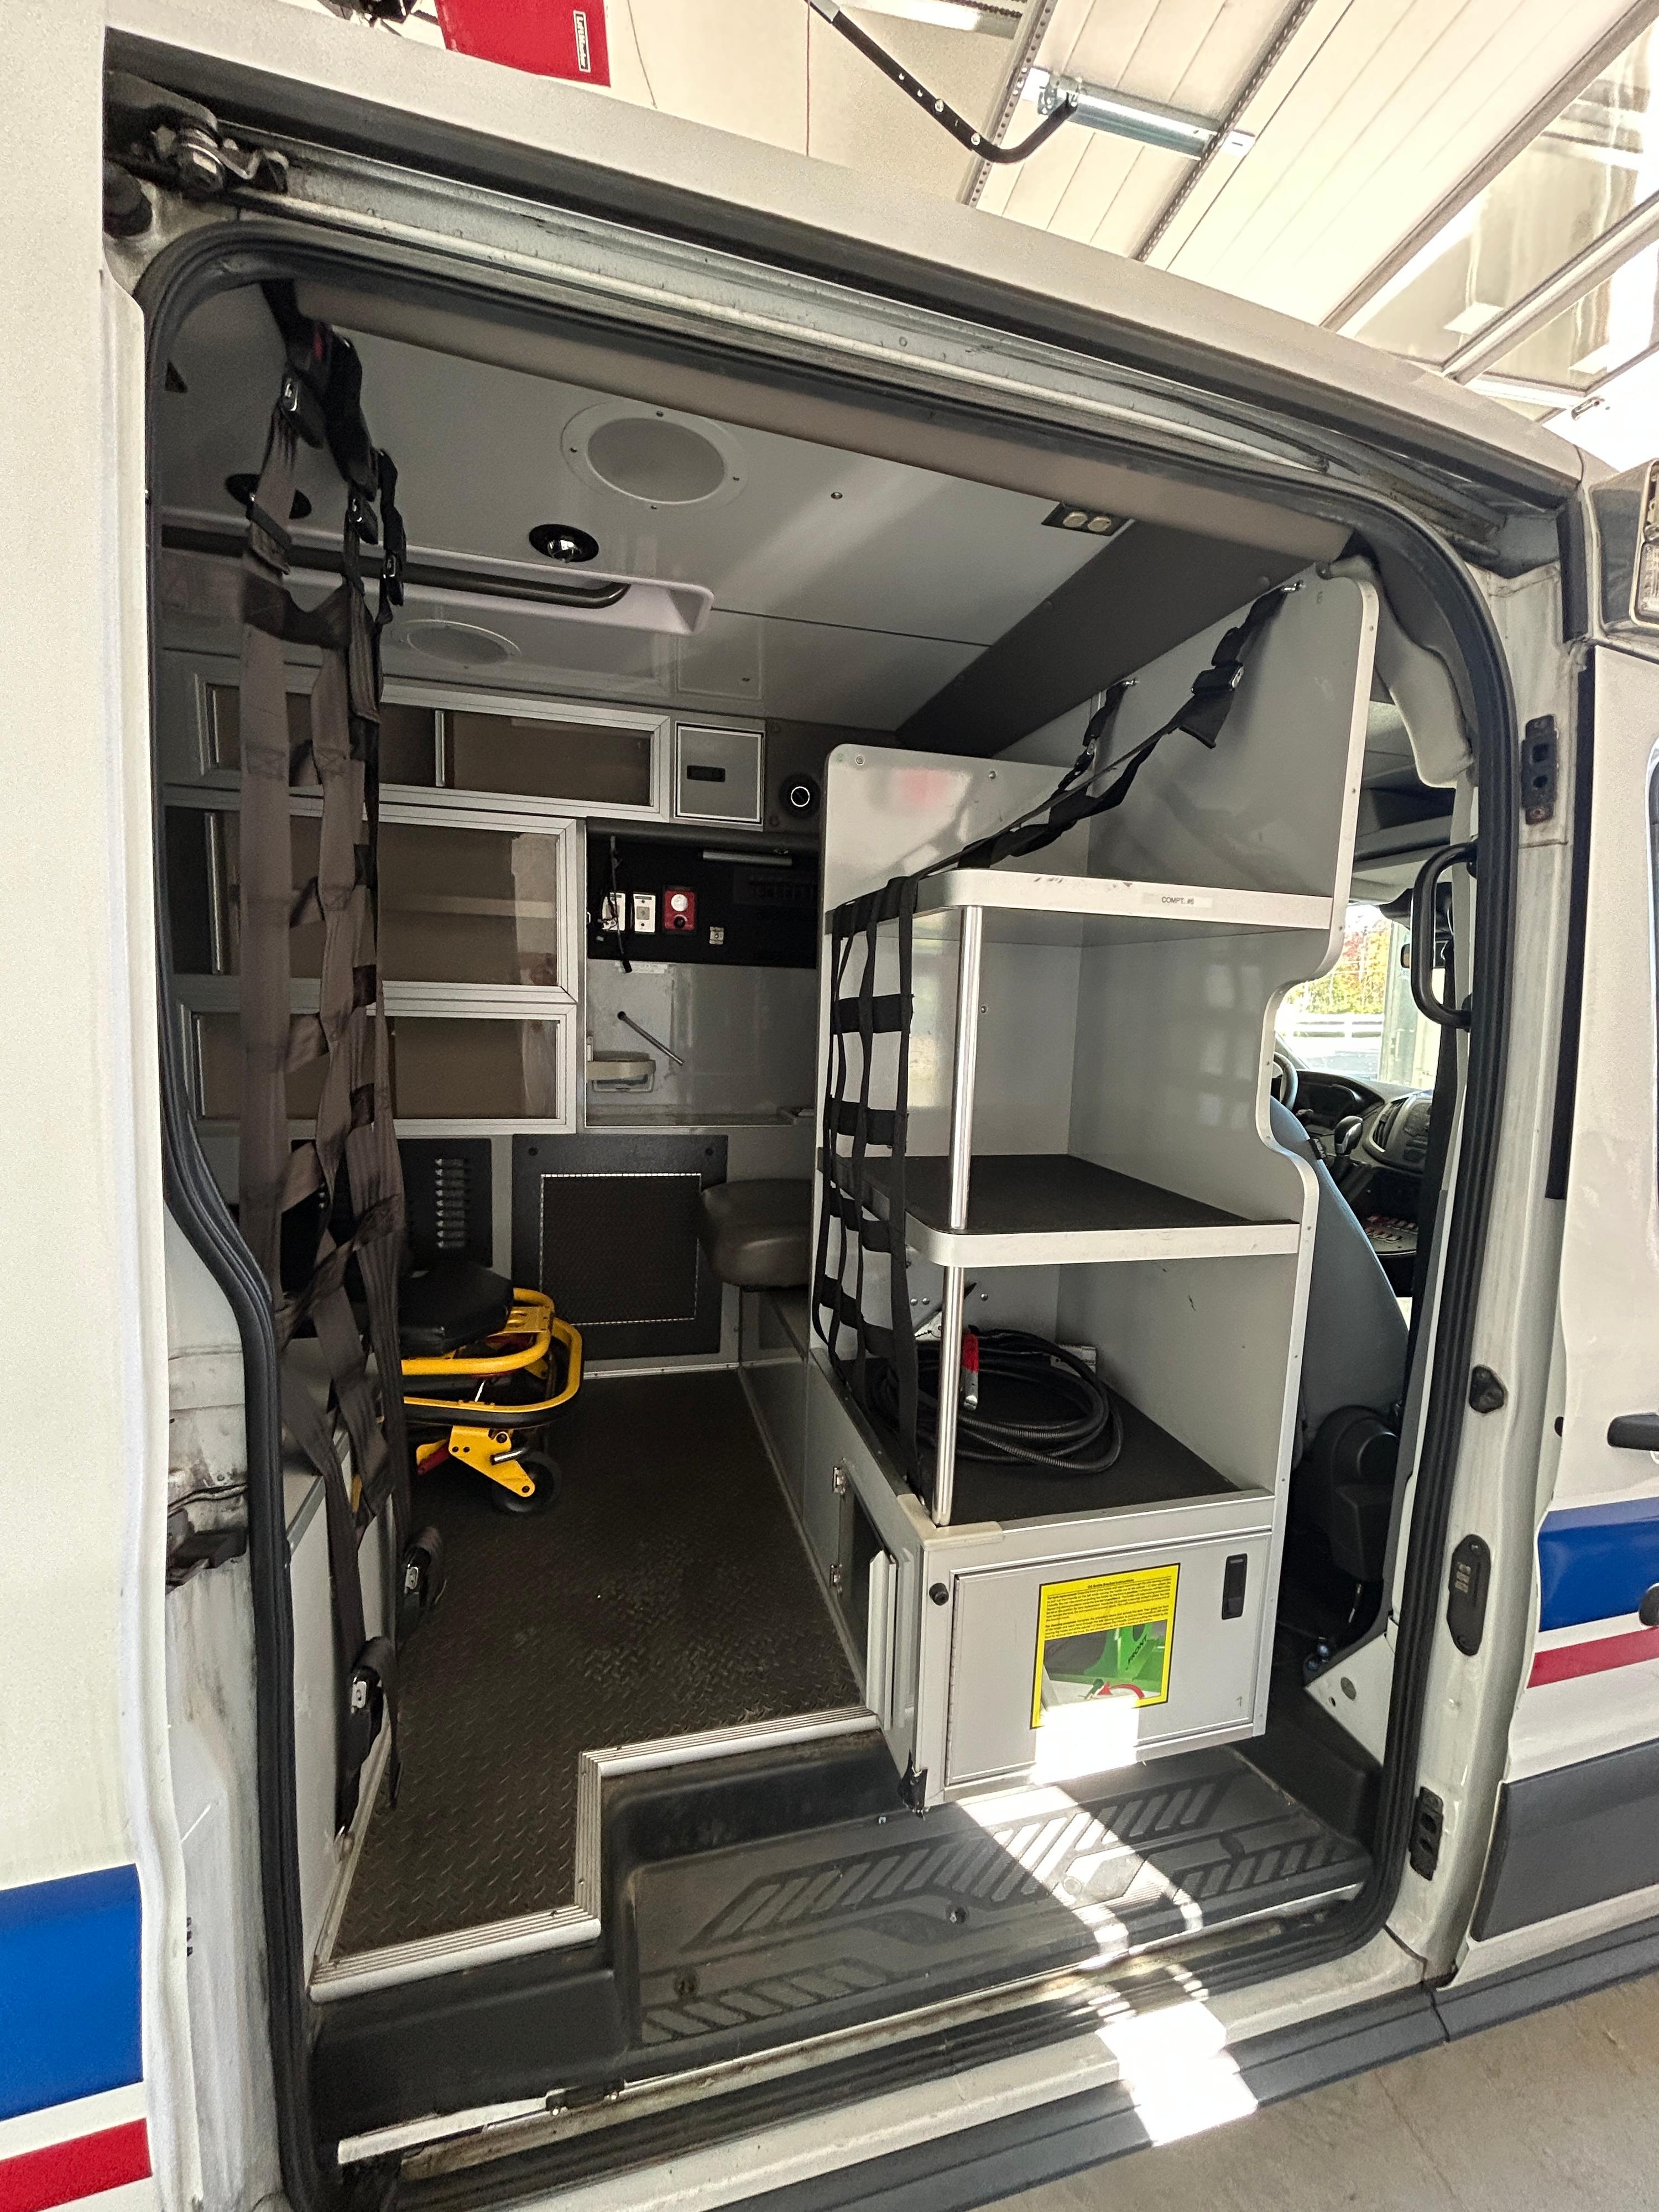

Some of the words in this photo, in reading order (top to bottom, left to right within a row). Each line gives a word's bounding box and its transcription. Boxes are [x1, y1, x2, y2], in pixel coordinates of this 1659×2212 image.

[1161, 896, 1186, 904] COMPT.
[1313, 1138, 1327, 1159] AIRBAG
[1128, 1633, 1147, 1665] FRONT
